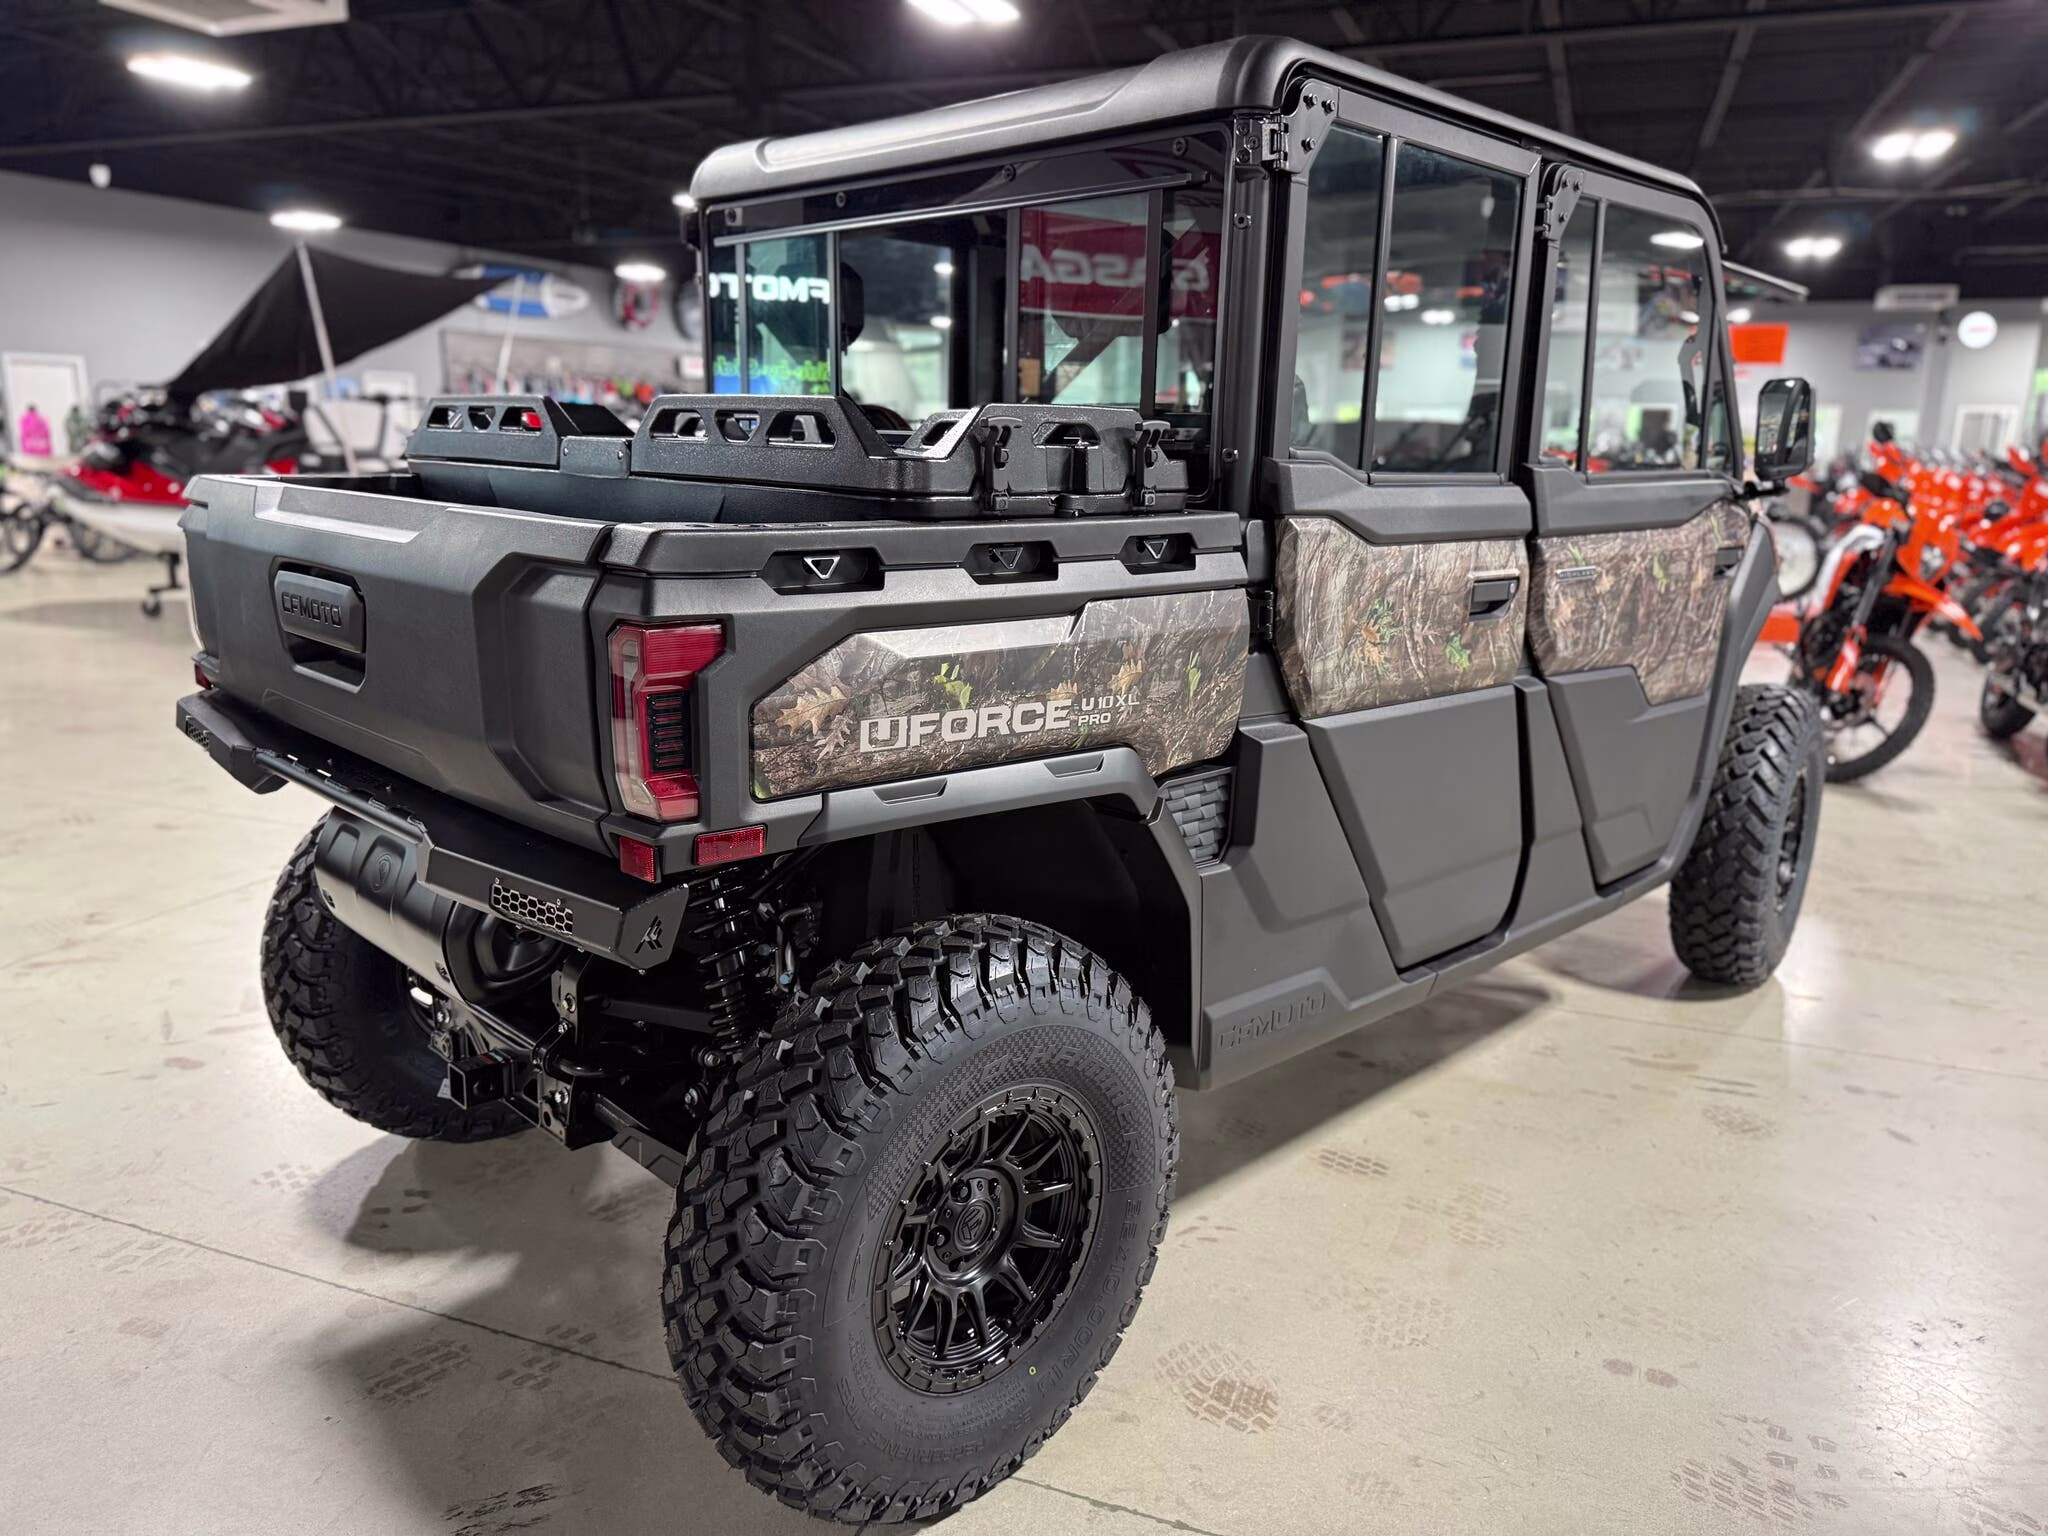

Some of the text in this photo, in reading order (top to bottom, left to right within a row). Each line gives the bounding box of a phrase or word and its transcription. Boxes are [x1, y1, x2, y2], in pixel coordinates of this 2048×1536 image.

[281, 592, 342, 627] CFMOTO
[860, 699, 1073, 751] UFORCE
[1077, 712, 1112, 727] PRO
[1217, 991, 1327, 1052] CFMOTO
